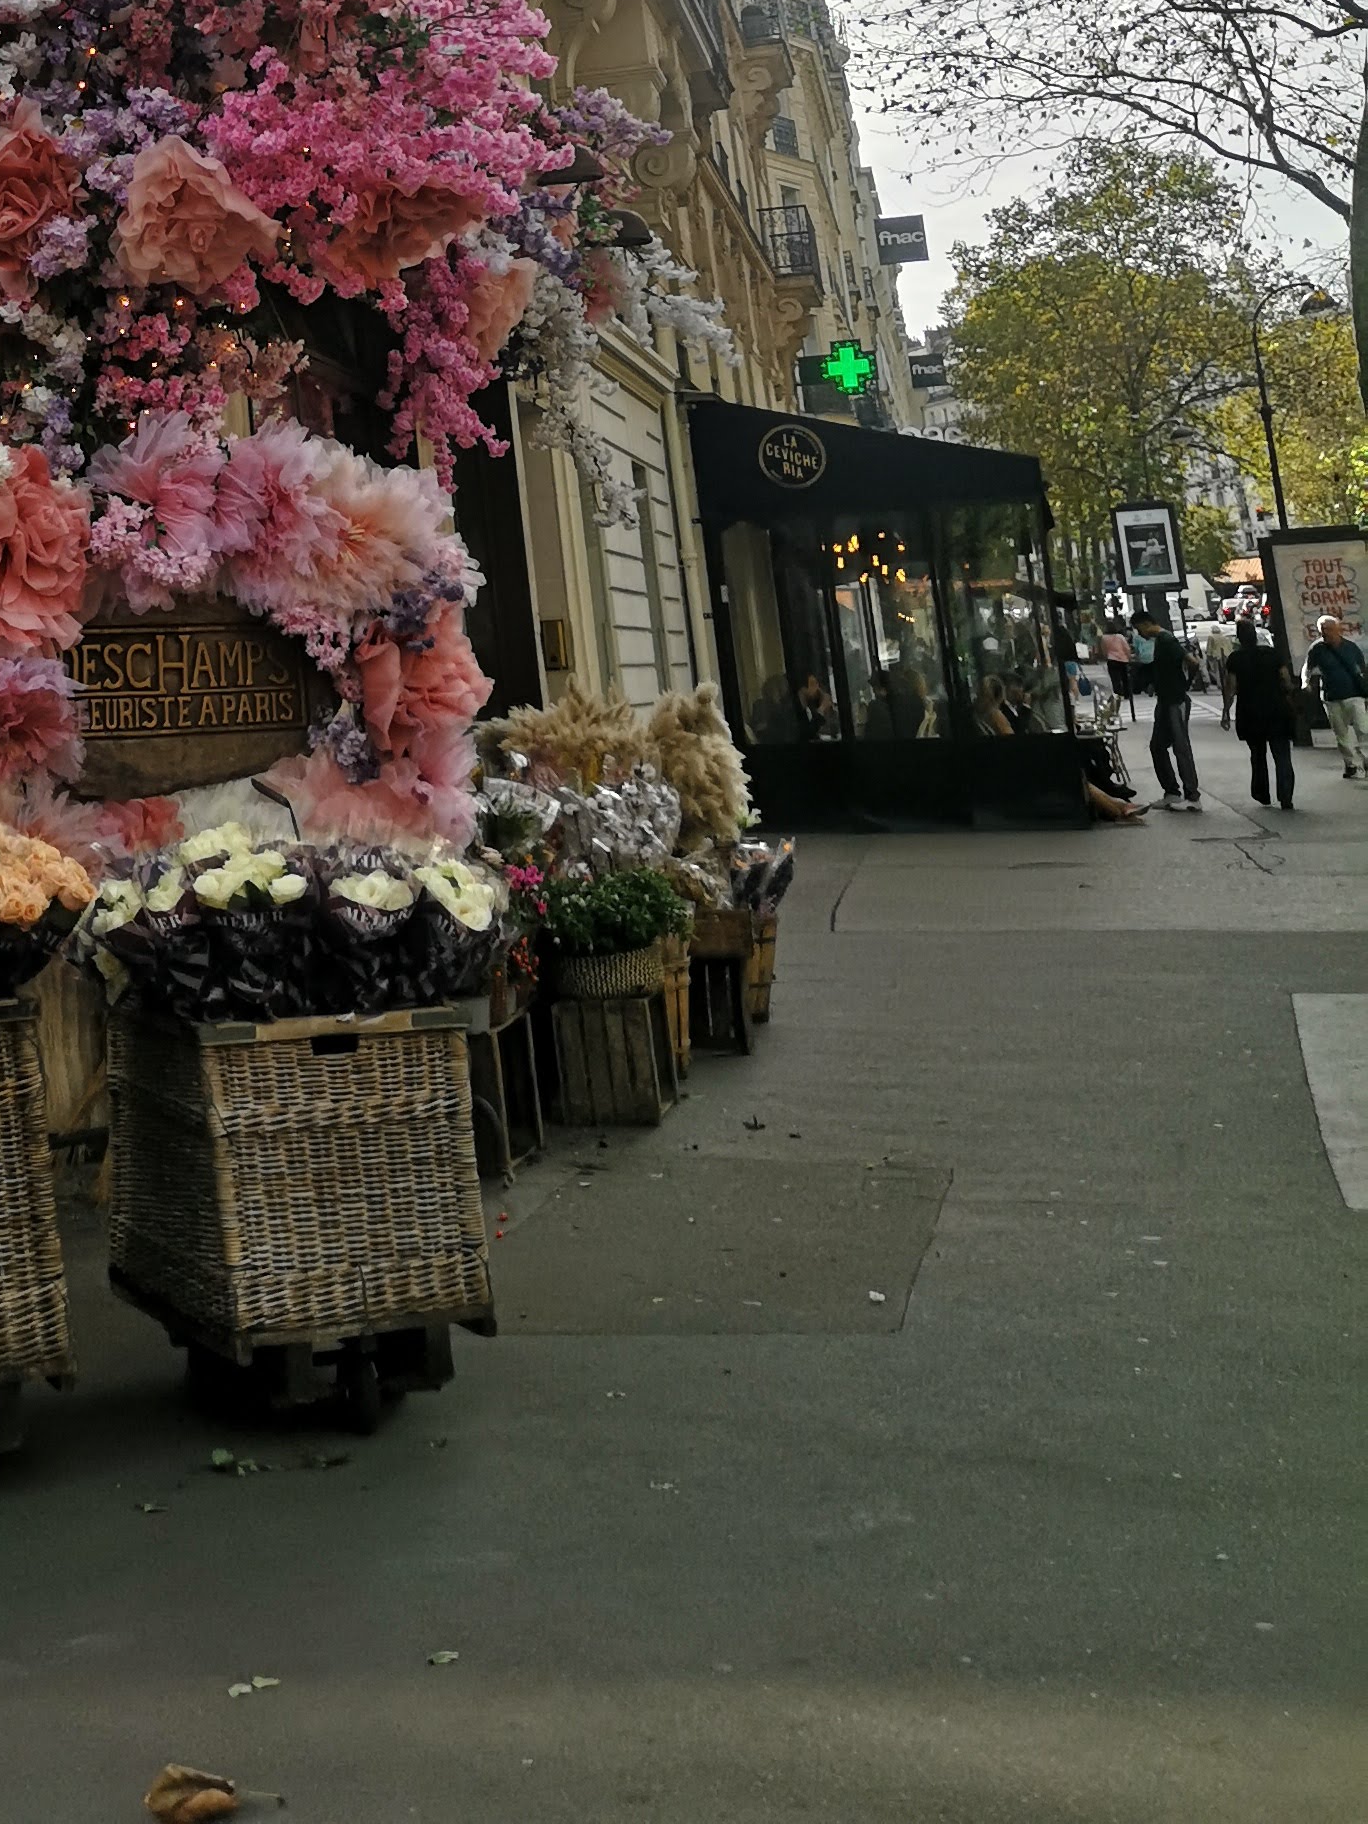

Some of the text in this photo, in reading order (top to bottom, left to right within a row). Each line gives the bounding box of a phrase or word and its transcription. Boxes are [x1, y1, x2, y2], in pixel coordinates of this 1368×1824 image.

[878, 229, 925, 247] fnac
[911, 363, 944, 376] fnac
[782, 433, 798, 448] LA
[765, 444, 819, 470] CEVICHE
[782, 462, 803, 480] RIA
[1303, 558, 1343, 574] TOUT
[1304, 573, 1347, 590] CELA
[1301, 589, 1356, 607] FORME
